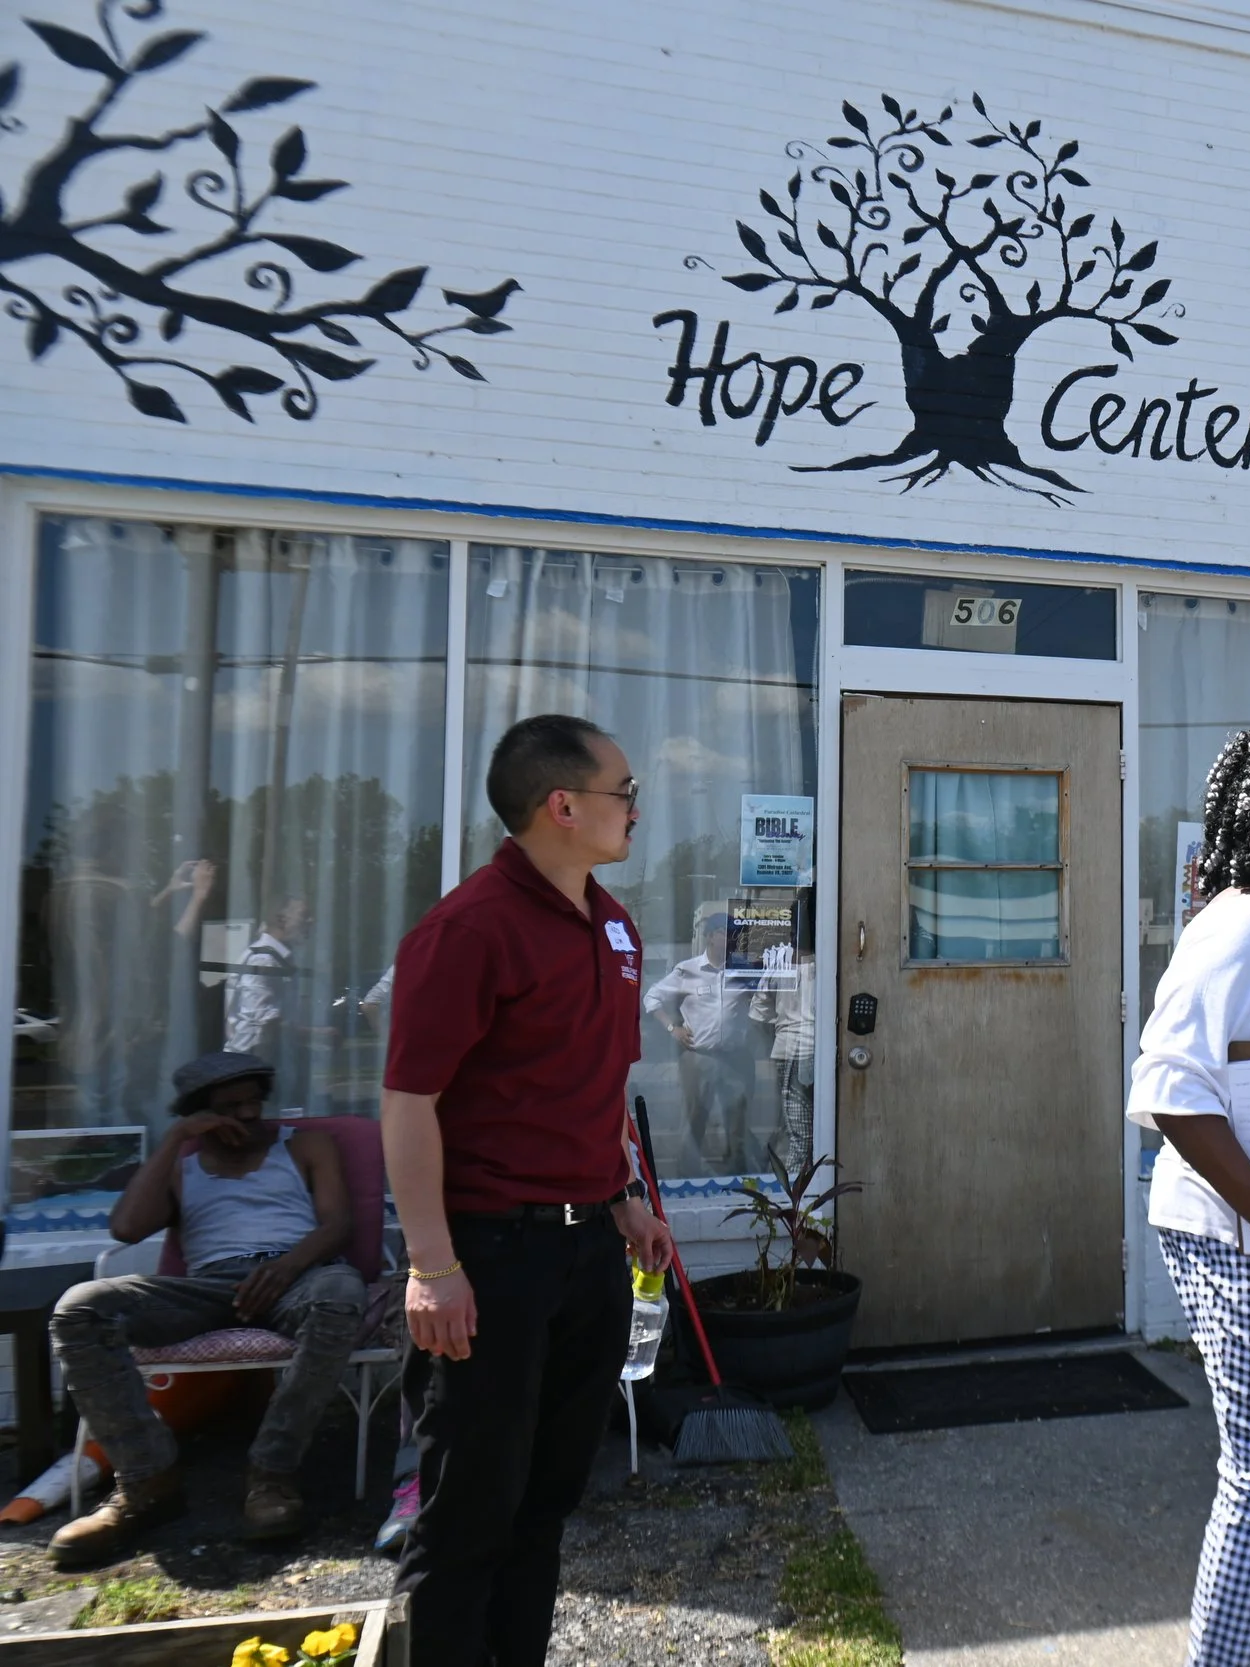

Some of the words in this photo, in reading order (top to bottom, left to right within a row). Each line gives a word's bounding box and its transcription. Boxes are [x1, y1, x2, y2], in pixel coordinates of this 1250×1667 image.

[652, 308, 879, 448] Hope
[954, 599, 1018, 625] 506
[755, 816, 799, 838] BIBLE
[733, 907, 793, 920] KINGS
[733, 919, 792, 927] GATHERING
